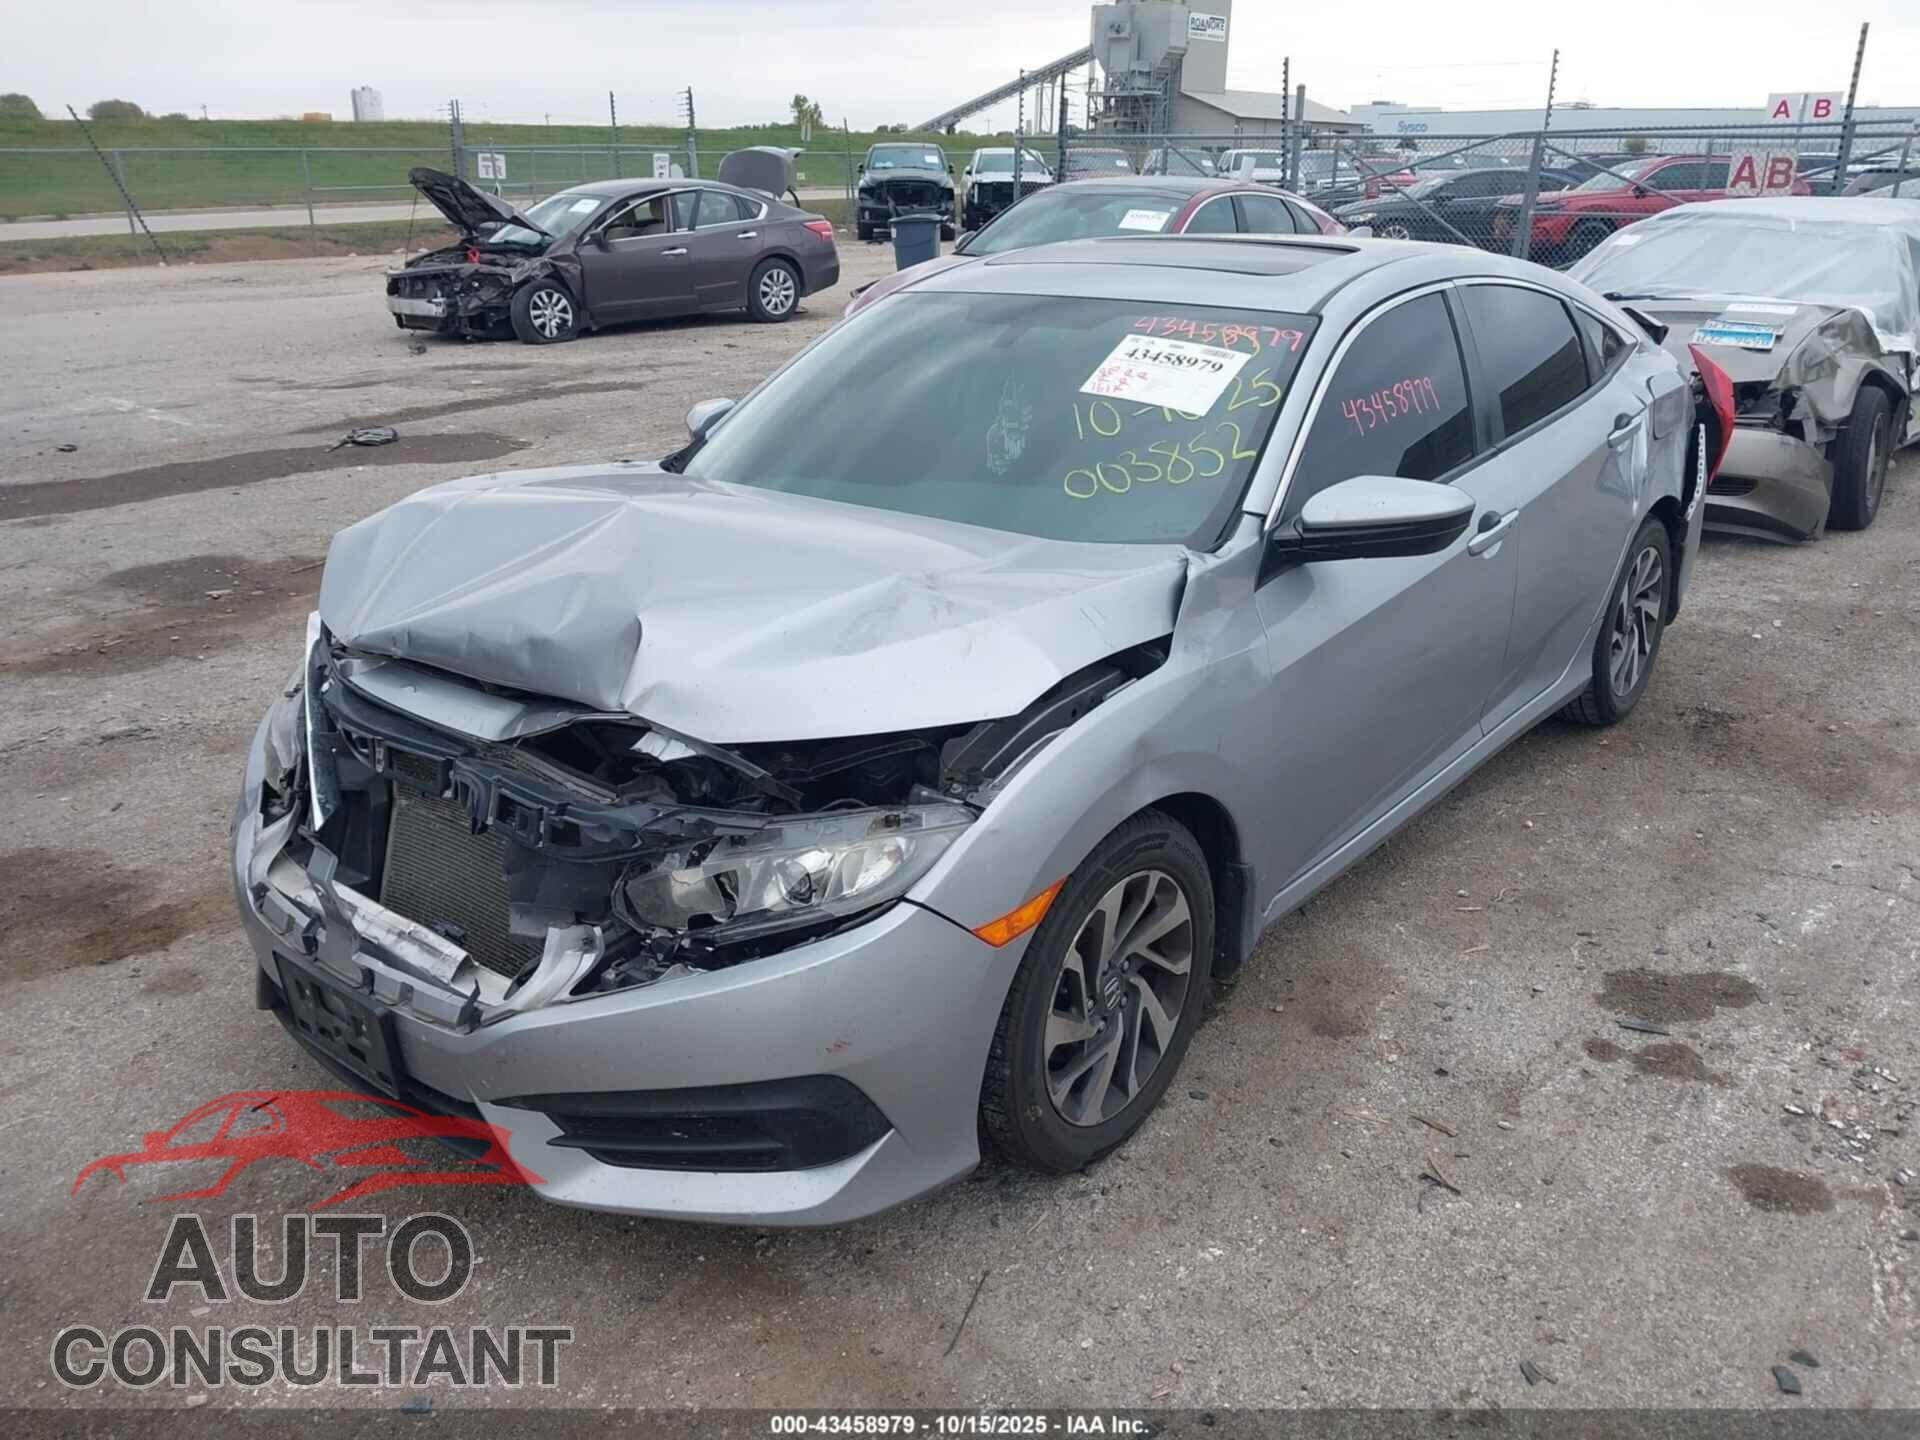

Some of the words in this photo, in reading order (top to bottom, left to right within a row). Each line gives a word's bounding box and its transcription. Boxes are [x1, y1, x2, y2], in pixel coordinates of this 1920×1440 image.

[1772, 99, 1790, 119] A
[1813, 98, 1831, 118] B
[1398, 120, 1429, 136] Sysco
[1124, 346, 1225, 374] 43458979
[1341, 377, 1441, 436] 43458979
[1064, 422, 1257, 498] 003852
